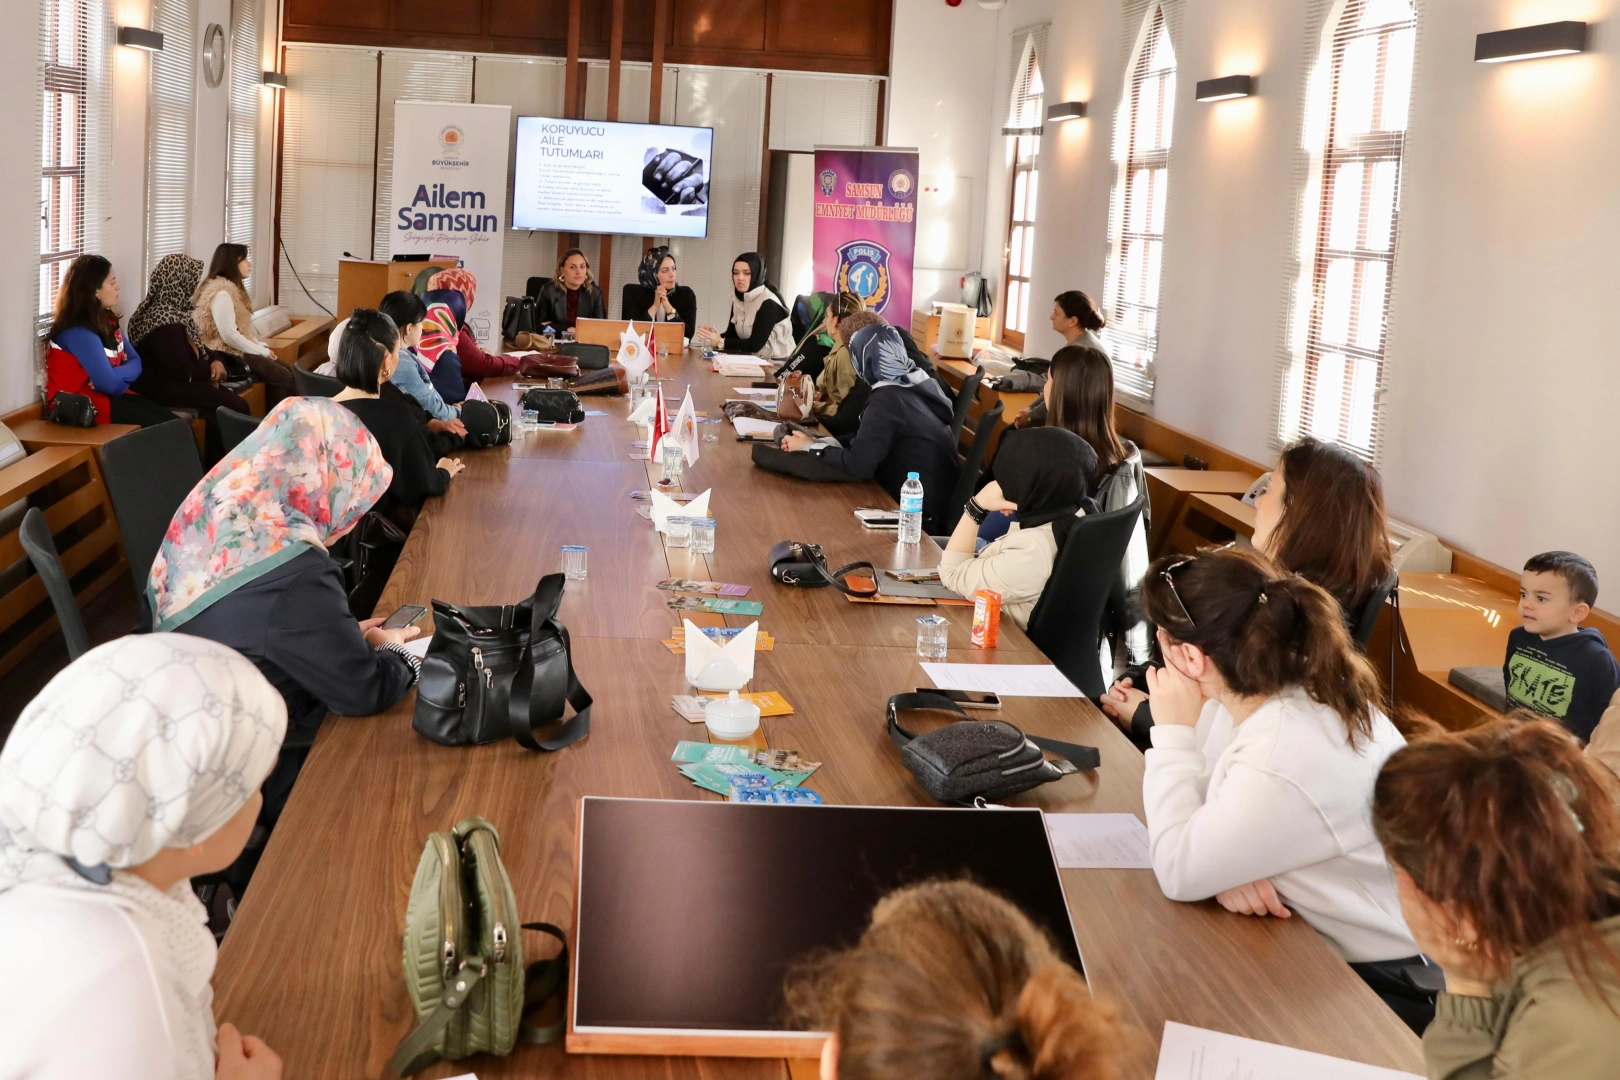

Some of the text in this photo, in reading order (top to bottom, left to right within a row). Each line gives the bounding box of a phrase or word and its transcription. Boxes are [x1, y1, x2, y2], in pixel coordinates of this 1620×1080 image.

[541, 124, 605, 137] KORUYUCU
[540, 135, 565, 146] AİLE
[540, 147, 604, 160] TUTUMLARI
[431, 159, 470, 167] BÜYÜKŞEHİR
[411, 183, 486, 209] Ailem
[845, 182, 883, 199] SAMSUN
[815, 199, 914, 222] EMNİYET MÜDÜRLÜĞÜ
[397, 206, 498, 232] Samsun
[853, 247, 875, 257] POLİS
[789, 353, 806, 370] FORGET
